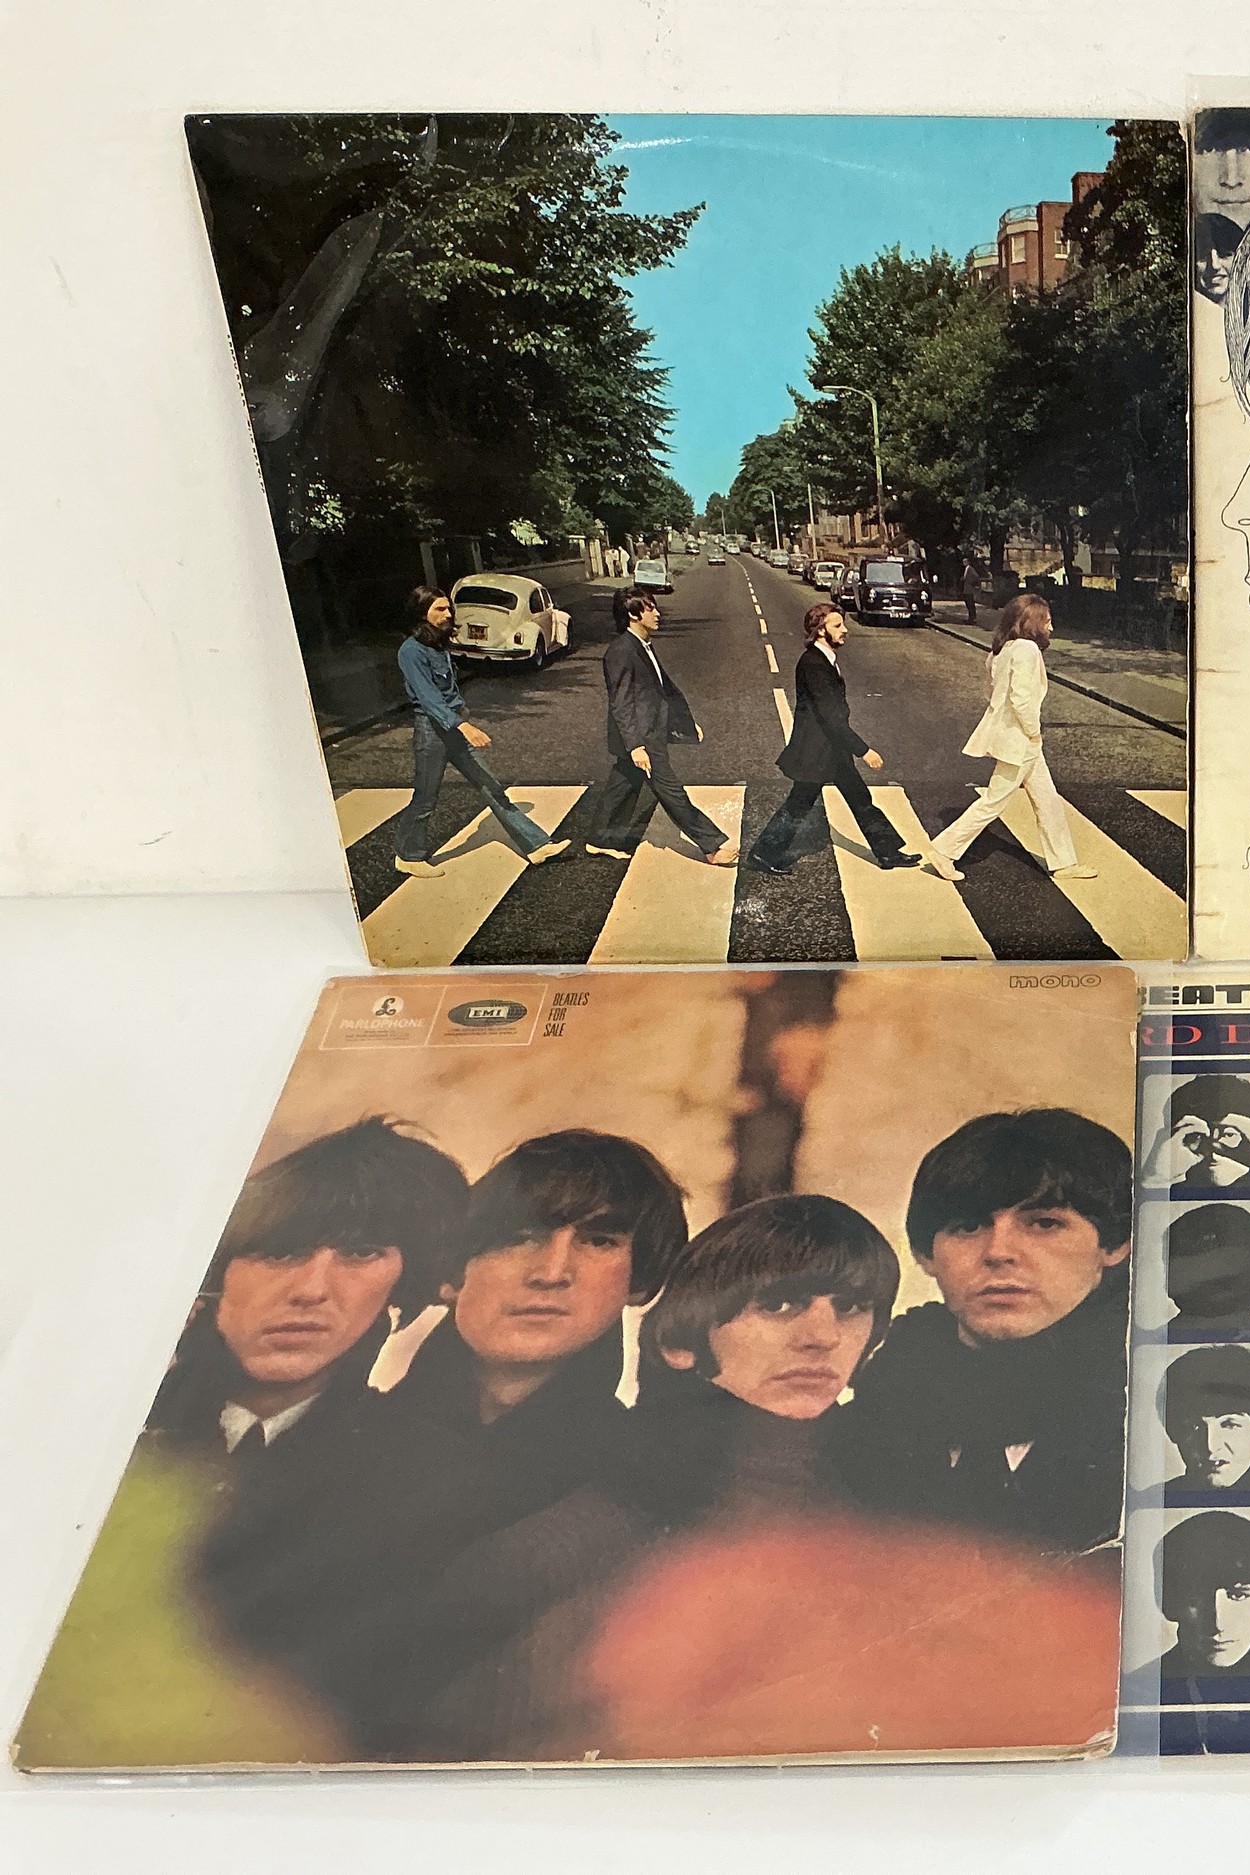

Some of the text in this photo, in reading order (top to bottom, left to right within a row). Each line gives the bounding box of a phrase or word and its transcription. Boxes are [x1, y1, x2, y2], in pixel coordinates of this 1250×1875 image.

[1010, 974, 1102, 988] mono
[552, 992, 590, 1007] BEATLES
[473, 1009, 502, 1017] EMI
[548, 1007, 567, 1021] FOR
[543, 1023, 566, 1037] SALE
